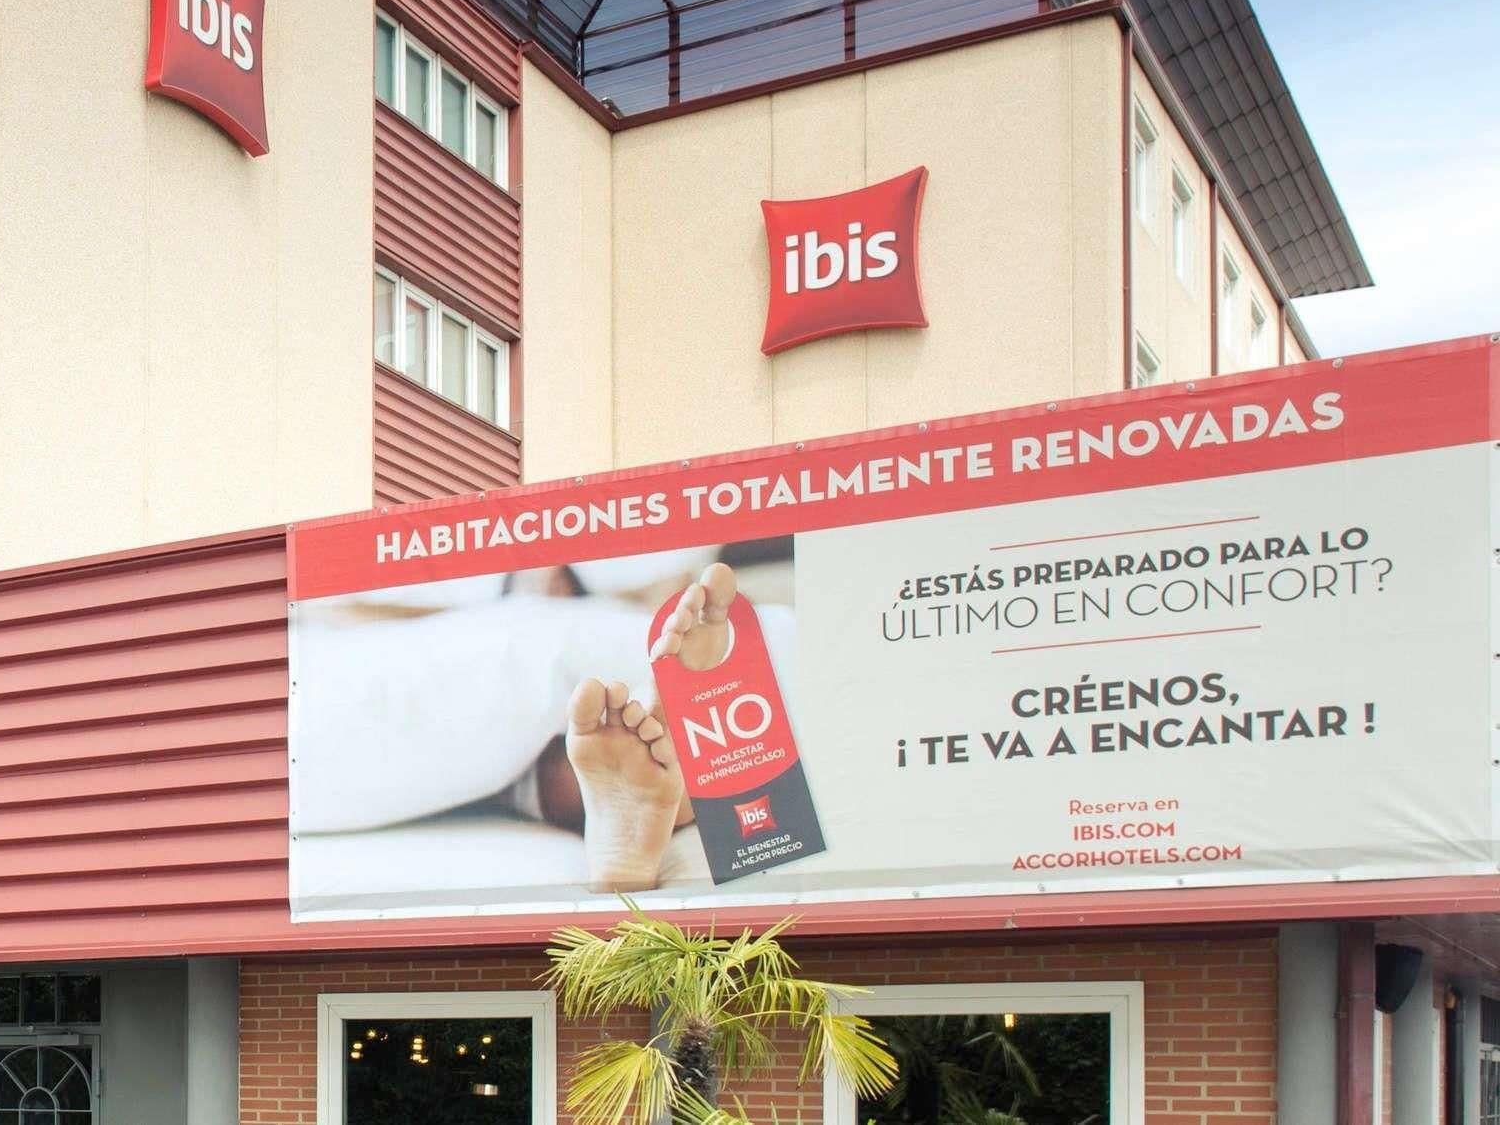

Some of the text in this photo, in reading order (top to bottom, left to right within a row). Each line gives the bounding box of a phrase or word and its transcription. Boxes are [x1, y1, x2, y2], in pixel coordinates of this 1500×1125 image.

[785, 222, 899, 294] ibis
[377, 391, 1345, 564] HABITACIONES TOTALMENTE RENOVADAS
[899, 526, 1369, 602] ¿ESTÁS PREPARADO PARA LO
[882, 557, 1394, 643] ÚLTIMO EN CONFORT?
[1011, 674, 1240, 719] CRÉENOS,
[682, 693, 772, 759] NO
[920, 733, 969, 764] TE
[982, 728, 1033, 761] VA
[1047, 726, 1076, 756] A
[1090, 704, 1347, 754] ENCANTAR
[710, 741, 765, 768] MOLESTAR
[753, 747, 786, 765] CASO)
[1068, 799, 1180, 817] Reserva en
[736, 834, 791, 857] EL BIENESTAR
[1073, 822, 1175, 841] IBIS.COM
[731, 841, 803, 870] AL MEJOR PRECIO
[1012, 844, 1242, 872] ACCORHOTELS.COM
